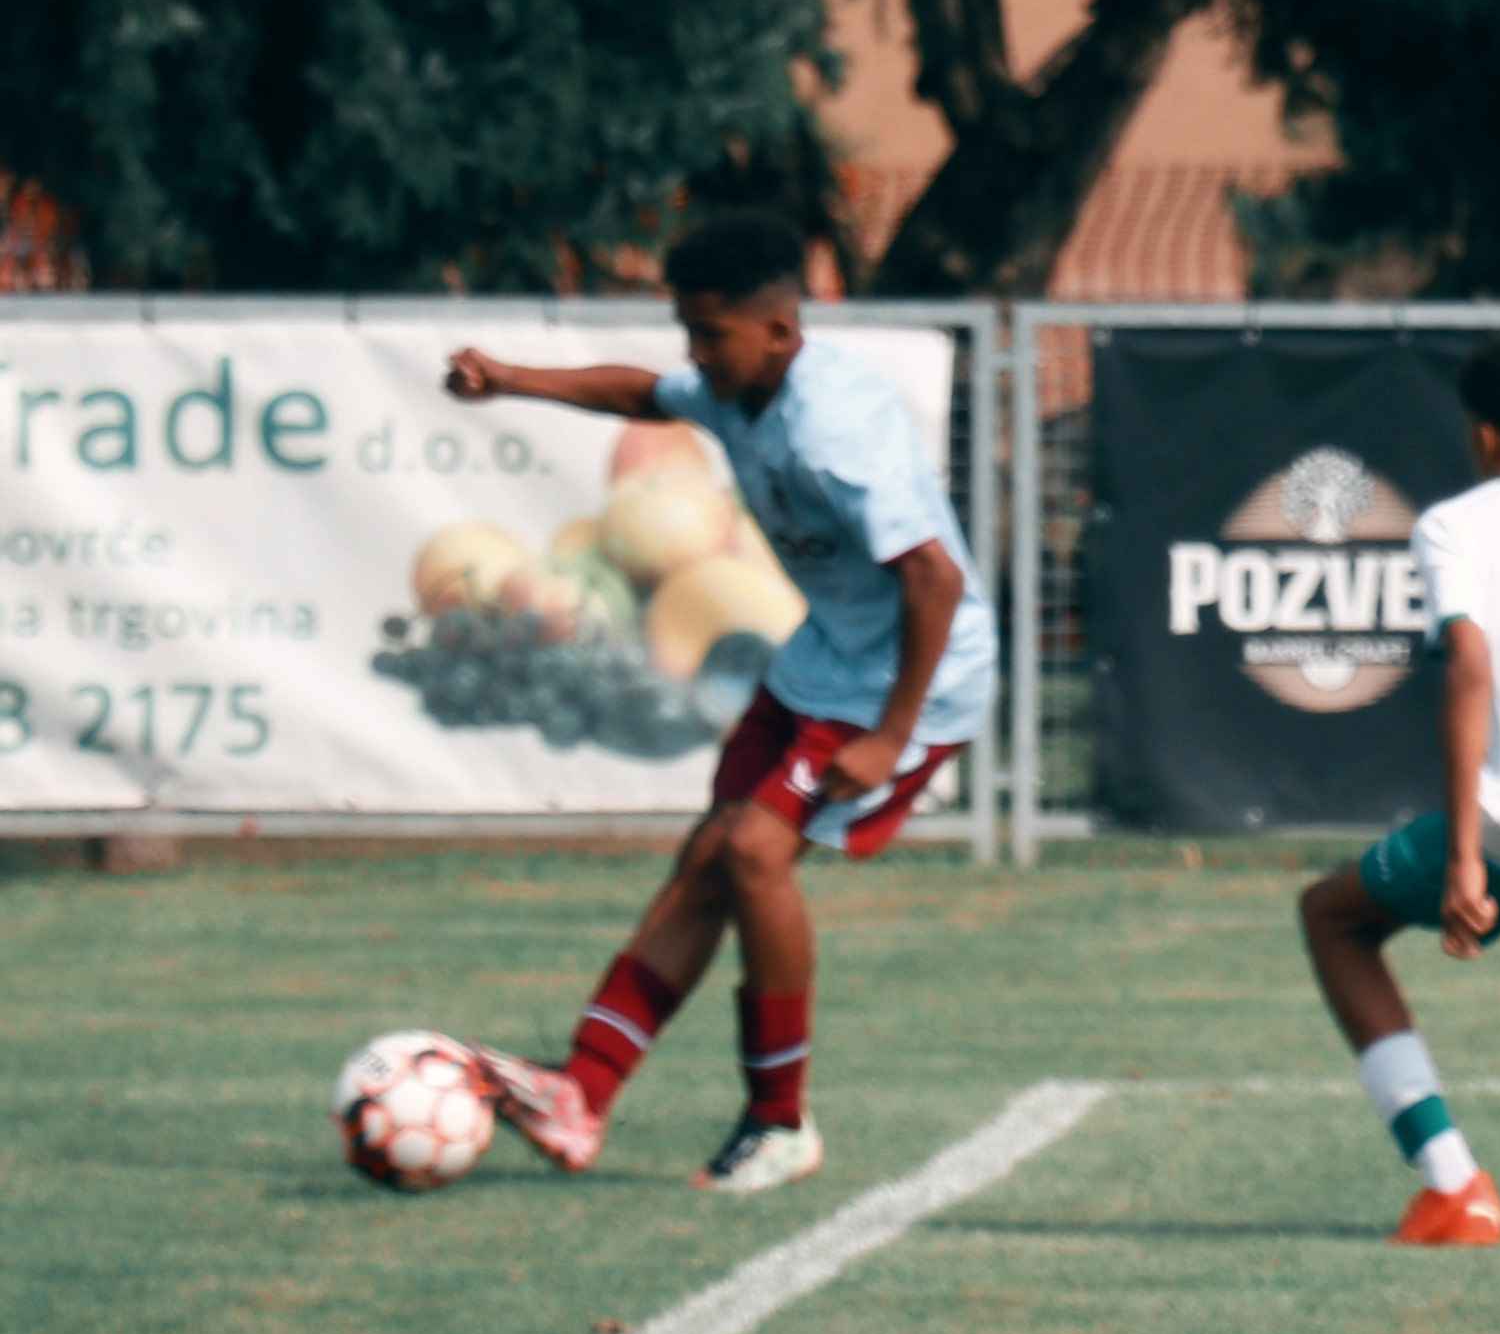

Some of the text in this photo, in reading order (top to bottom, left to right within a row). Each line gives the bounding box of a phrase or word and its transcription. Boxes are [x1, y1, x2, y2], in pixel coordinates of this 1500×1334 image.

[0, 355, 330, 470] rade
[66, 595, 320, 651] trgovina
[1168, 539, 1426, 635] POZVE
[73, 681, 271, 758] 2175
